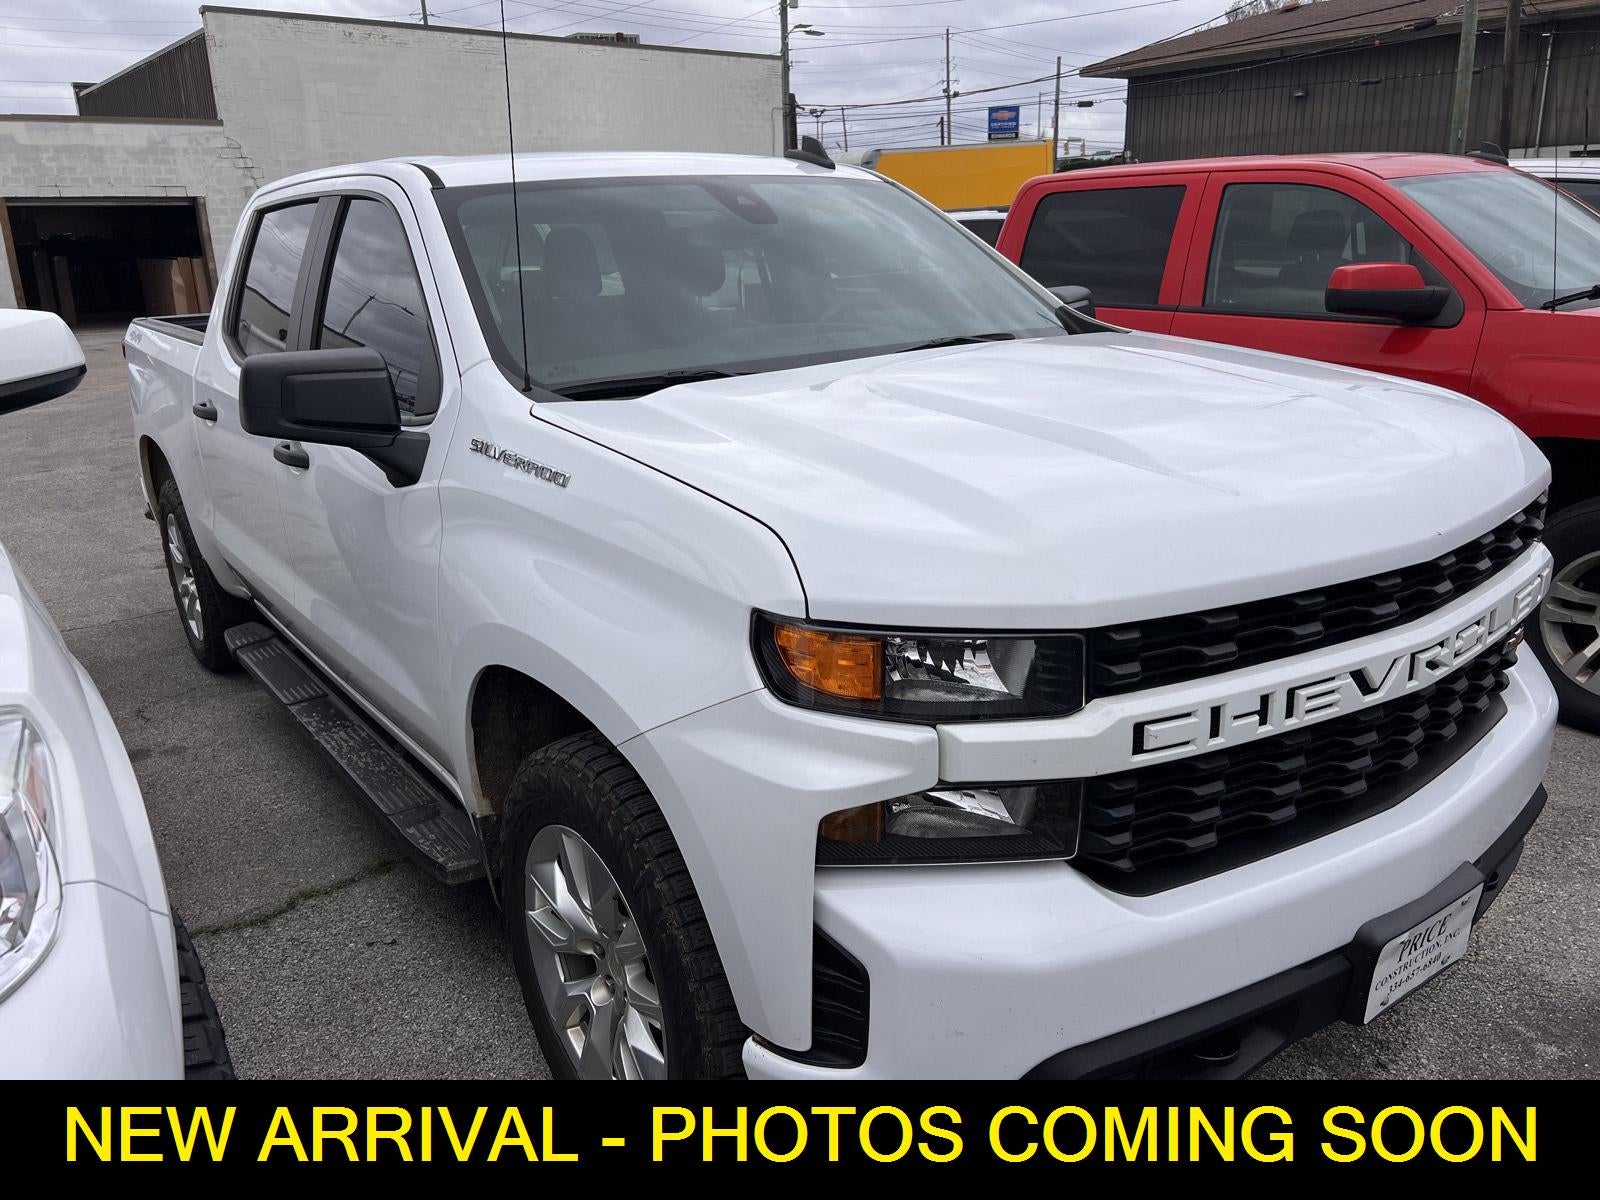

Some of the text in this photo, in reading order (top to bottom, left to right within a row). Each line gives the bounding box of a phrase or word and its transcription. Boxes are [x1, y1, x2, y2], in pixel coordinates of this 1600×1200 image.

[469, 437, 572, 488] SILVERADO
[1130, 563, 1551, 761] CHEVROLET
[1374, 927, 1461, 992] CONSTRUCTION, INC.
[1397, 912, 1452, 963] PRICE
